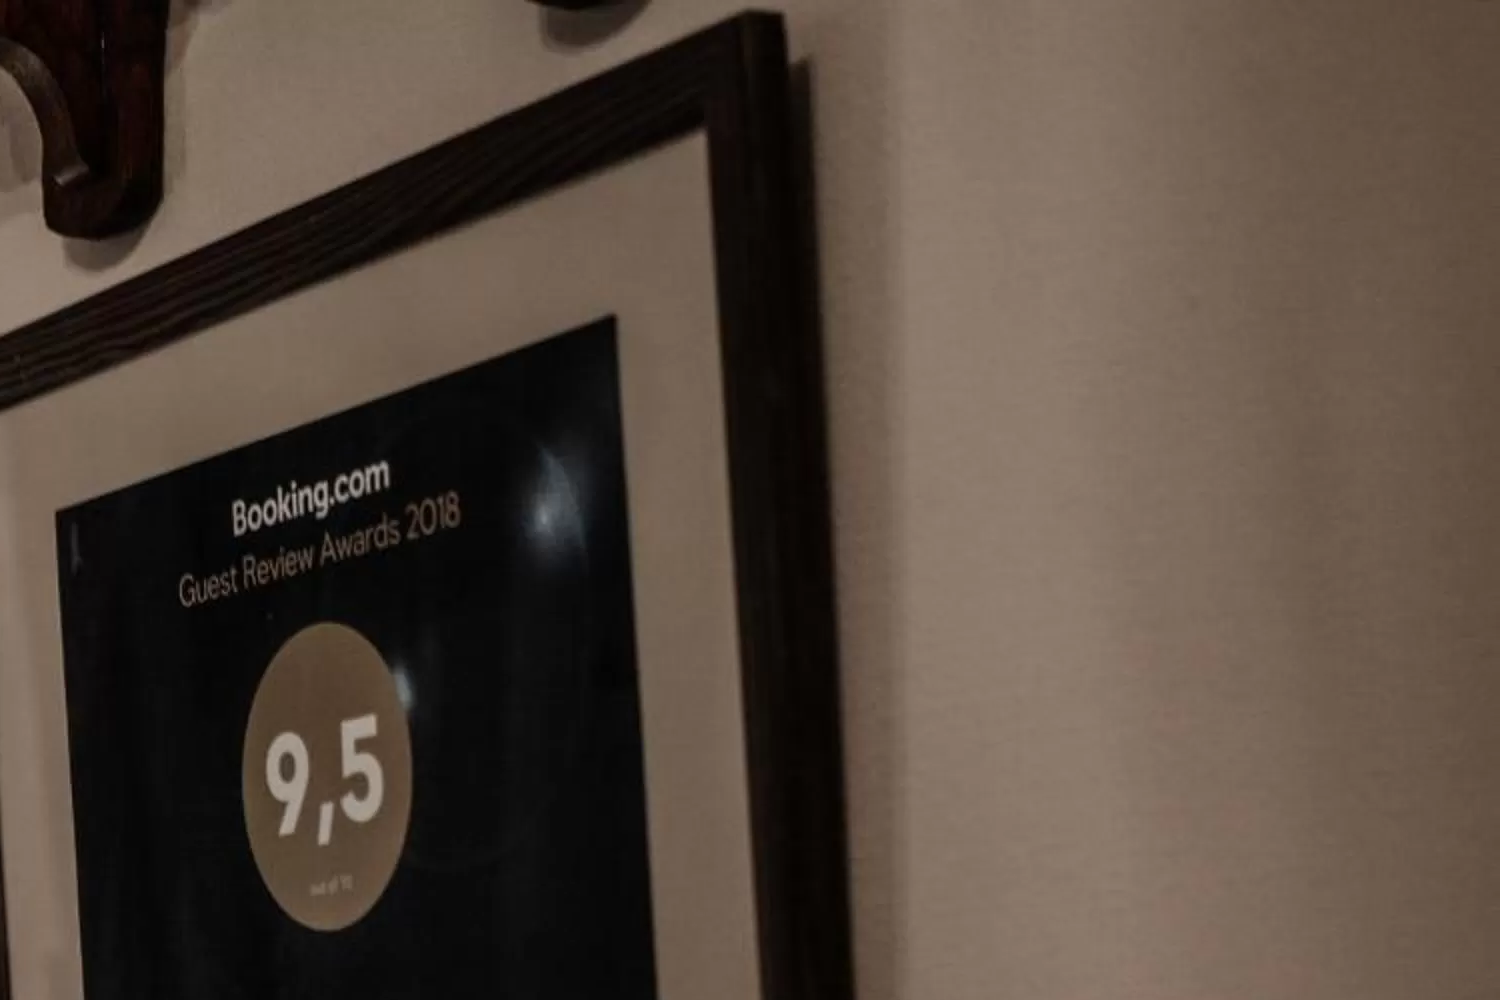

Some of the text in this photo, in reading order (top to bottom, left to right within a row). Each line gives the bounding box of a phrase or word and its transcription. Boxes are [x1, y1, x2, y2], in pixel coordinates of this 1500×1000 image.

[178, 491, 462, 607] Guest Review Awards 2018
[232, 460, 390, 537] Booking.com
[265, 713, 385, 846] 9,5
